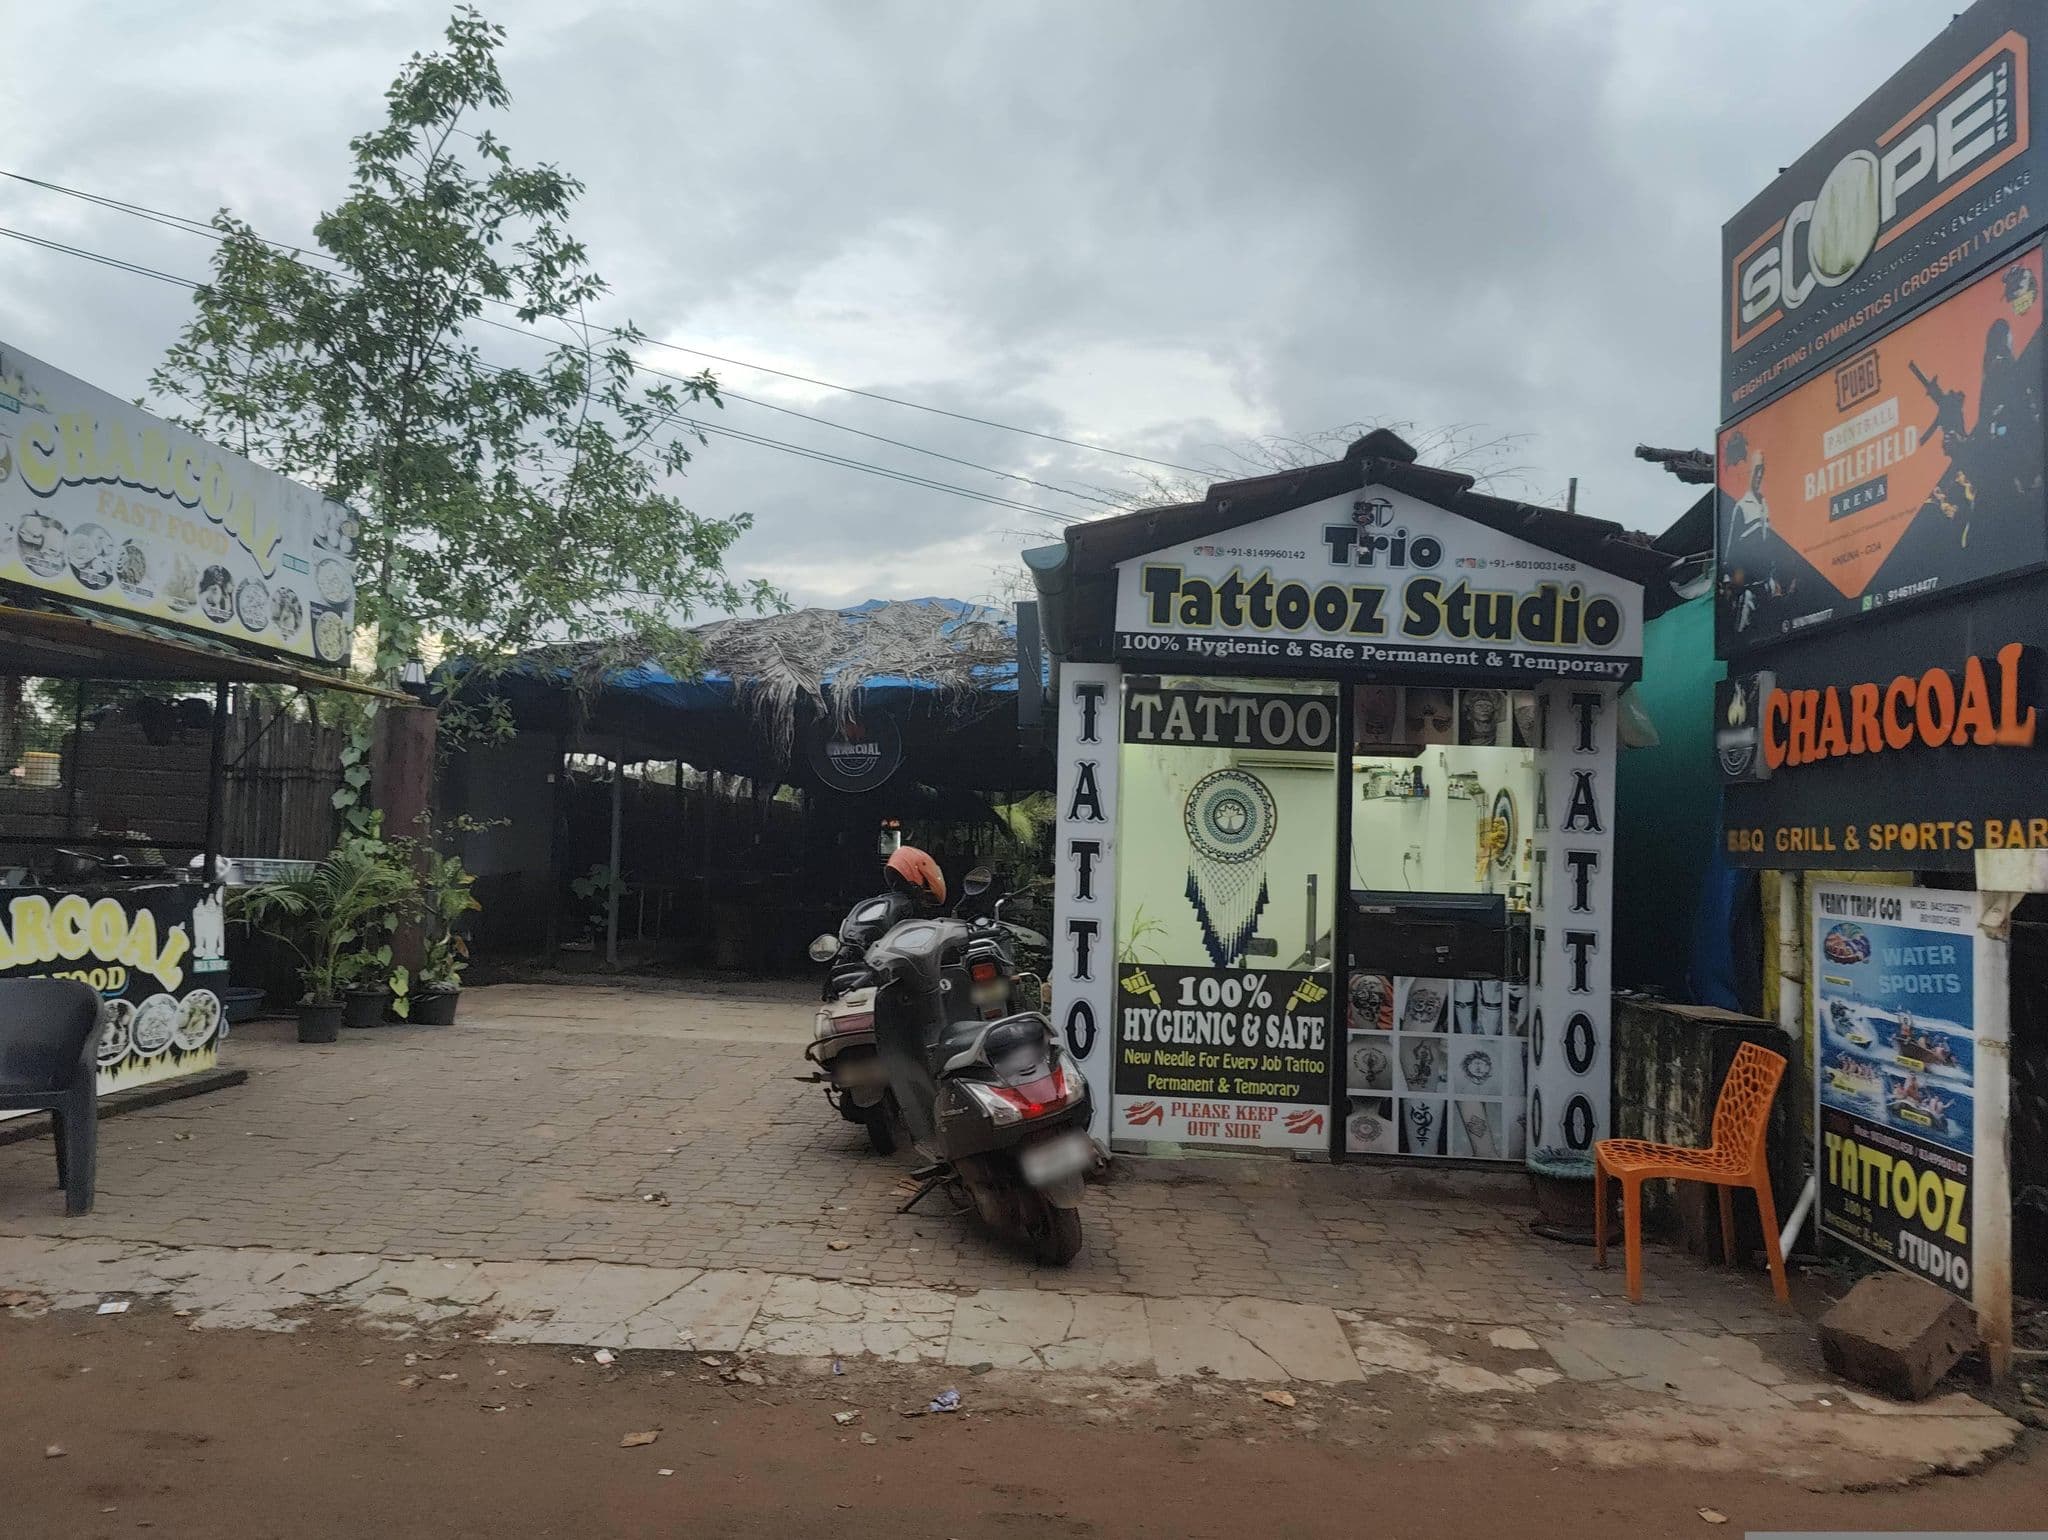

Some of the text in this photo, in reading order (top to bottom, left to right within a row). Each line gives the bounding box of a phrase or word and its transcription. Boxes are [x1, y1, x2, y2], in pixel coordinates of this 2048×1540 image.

[1743, 70, 1995, 323] SCOPE
[1732, 346, 1808, 403] WEIGHTLIFTING
[1815, 292, 1892, 351] GYMNASTICS
[1902, 240, 1971, 297] CROSSFIT
[1982, 205, 2029, 244] YOGA
[1841, 359, 1875, 402] PUBG
[1804, 425, 1918, 502] BATTLEFIELD
[1832, 483, 1886, 516] ARENA
[166, 511, 231, 557] FOOD
[1323, 524, 1444, 569] Trio
[1143, 566, 1623, 648] Tattooz Studio
[1122, 634, 1629, 678] 100% Hygienic & Safe Permanent & Temporary
[1131, 694, 1332, 747] TATTOO
[1764, 642, 2037, 770] CHARCOAL
[1775, 826, 1837, 852] GRILL
[1844, 824, 1861, 851] &
[1869, 820, 1975, 851] SPORTS
[1984, 817, 2048, 849] BAR
[1063, 681, 1107, 1133] TATTO
[1850, 895, 1877, 920] TRIPS
[1883, 945, 1957, 967] WATER
[1177, 973, 1273, 1010] 100%
[1878, 973, 1962, 994] SPORTS
[1123, 1007, 1325, 1050] HYGIENIC & SAFE
[1124, 1048, 1325, 1074] New Needle For Every Job Tattoo
[1147, 1074, 1300, 1097] Permanent & Temporary
[1171, 1101, 1279, 1122] PLEASE KEEP
[1187, 1121, 1261, 1140] OUT SIDE
[1824, 1131, 1968, 1245] TATTOOZ
[1899, 1230, 1969, 1290] STUDIO
